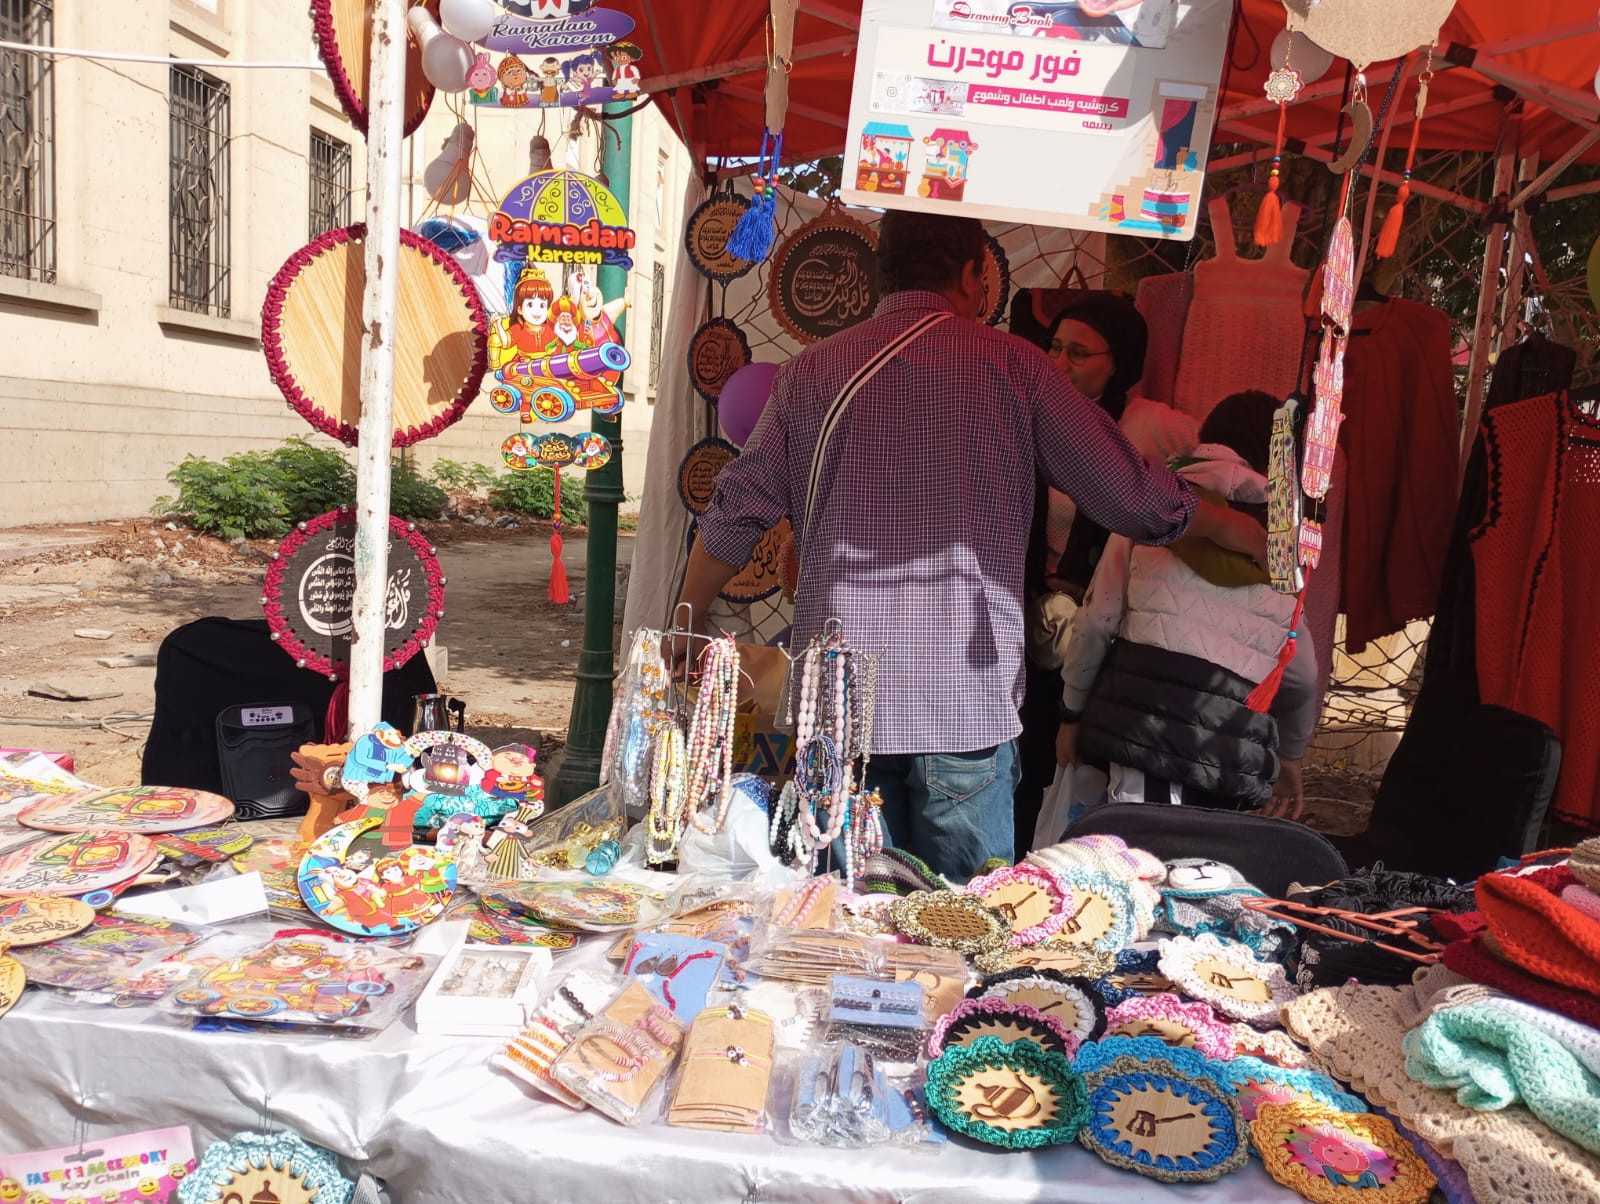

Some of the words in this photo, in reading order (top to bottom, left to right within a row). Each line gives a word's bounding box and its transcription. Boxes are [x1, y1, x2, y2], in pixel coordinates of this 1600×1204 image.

[949, 1, 1010, 25] Drawing
[1013, 6, 1053, 27] Book
[492, 19, 596, 38] Ramadan
[524, 31, 615, 48] Kareem
[926, 39, 1024, 79] مودرن
[1029, 48, 1082, 83] فور
[972, 88, 1010, 103] وشموع
[1047, 97, 1075, 111] ولعب
[489, 212, 635, 249] Ramadan
[528, 245, 602, 264] Kareem
[94, 1169, 140, 1185] Chain
